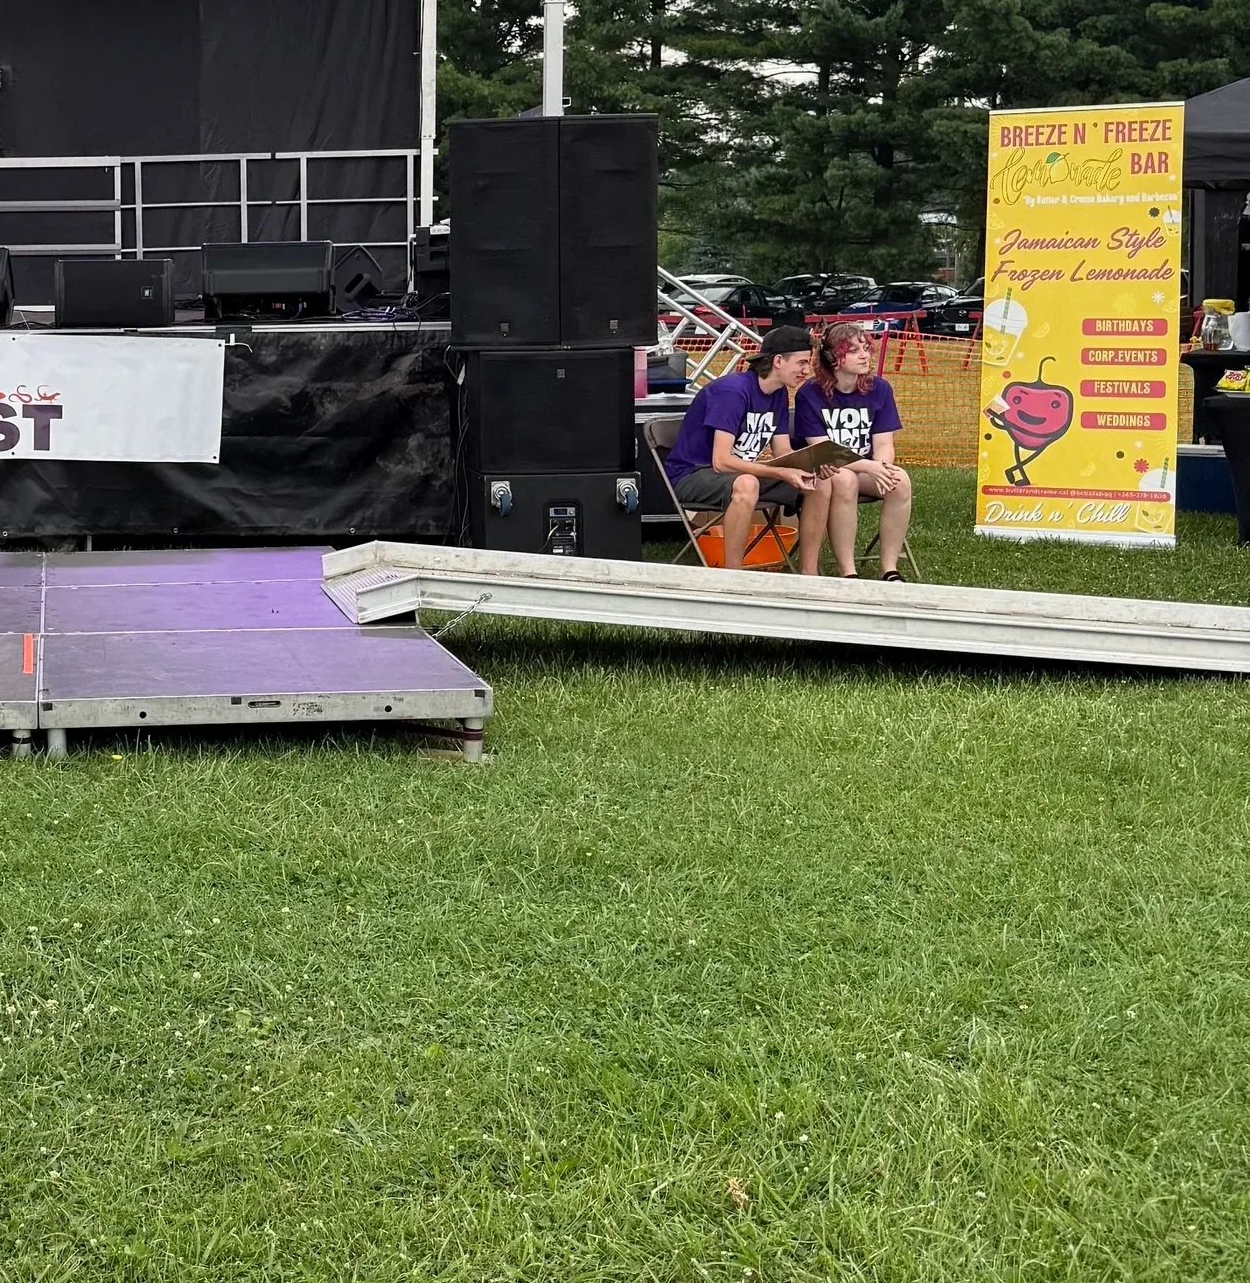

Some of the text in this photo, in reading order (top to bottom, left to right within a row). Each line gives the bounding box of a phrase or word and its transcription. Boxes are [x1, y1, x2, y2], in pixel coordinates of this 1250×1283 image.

[1000, 124, 1068, 148] BREEZE
[1104, 119, 1173, 144] FREEZE
[1130, 152, 1169, 175] BAR
[998, 227, 1167, 259] Jamaican Style
[991, 259, 1175, 291] Frozen Lemonade
[1095, 320, 1154, 332] BIRTHDAYS
[1094, 381, 1151, 394] FESTIVALS
[1096, 414, 1151, 427] WEDDINGS
[984, 500, 1043, 523] Drink
[1077, 501, 1131, 524] Chill
